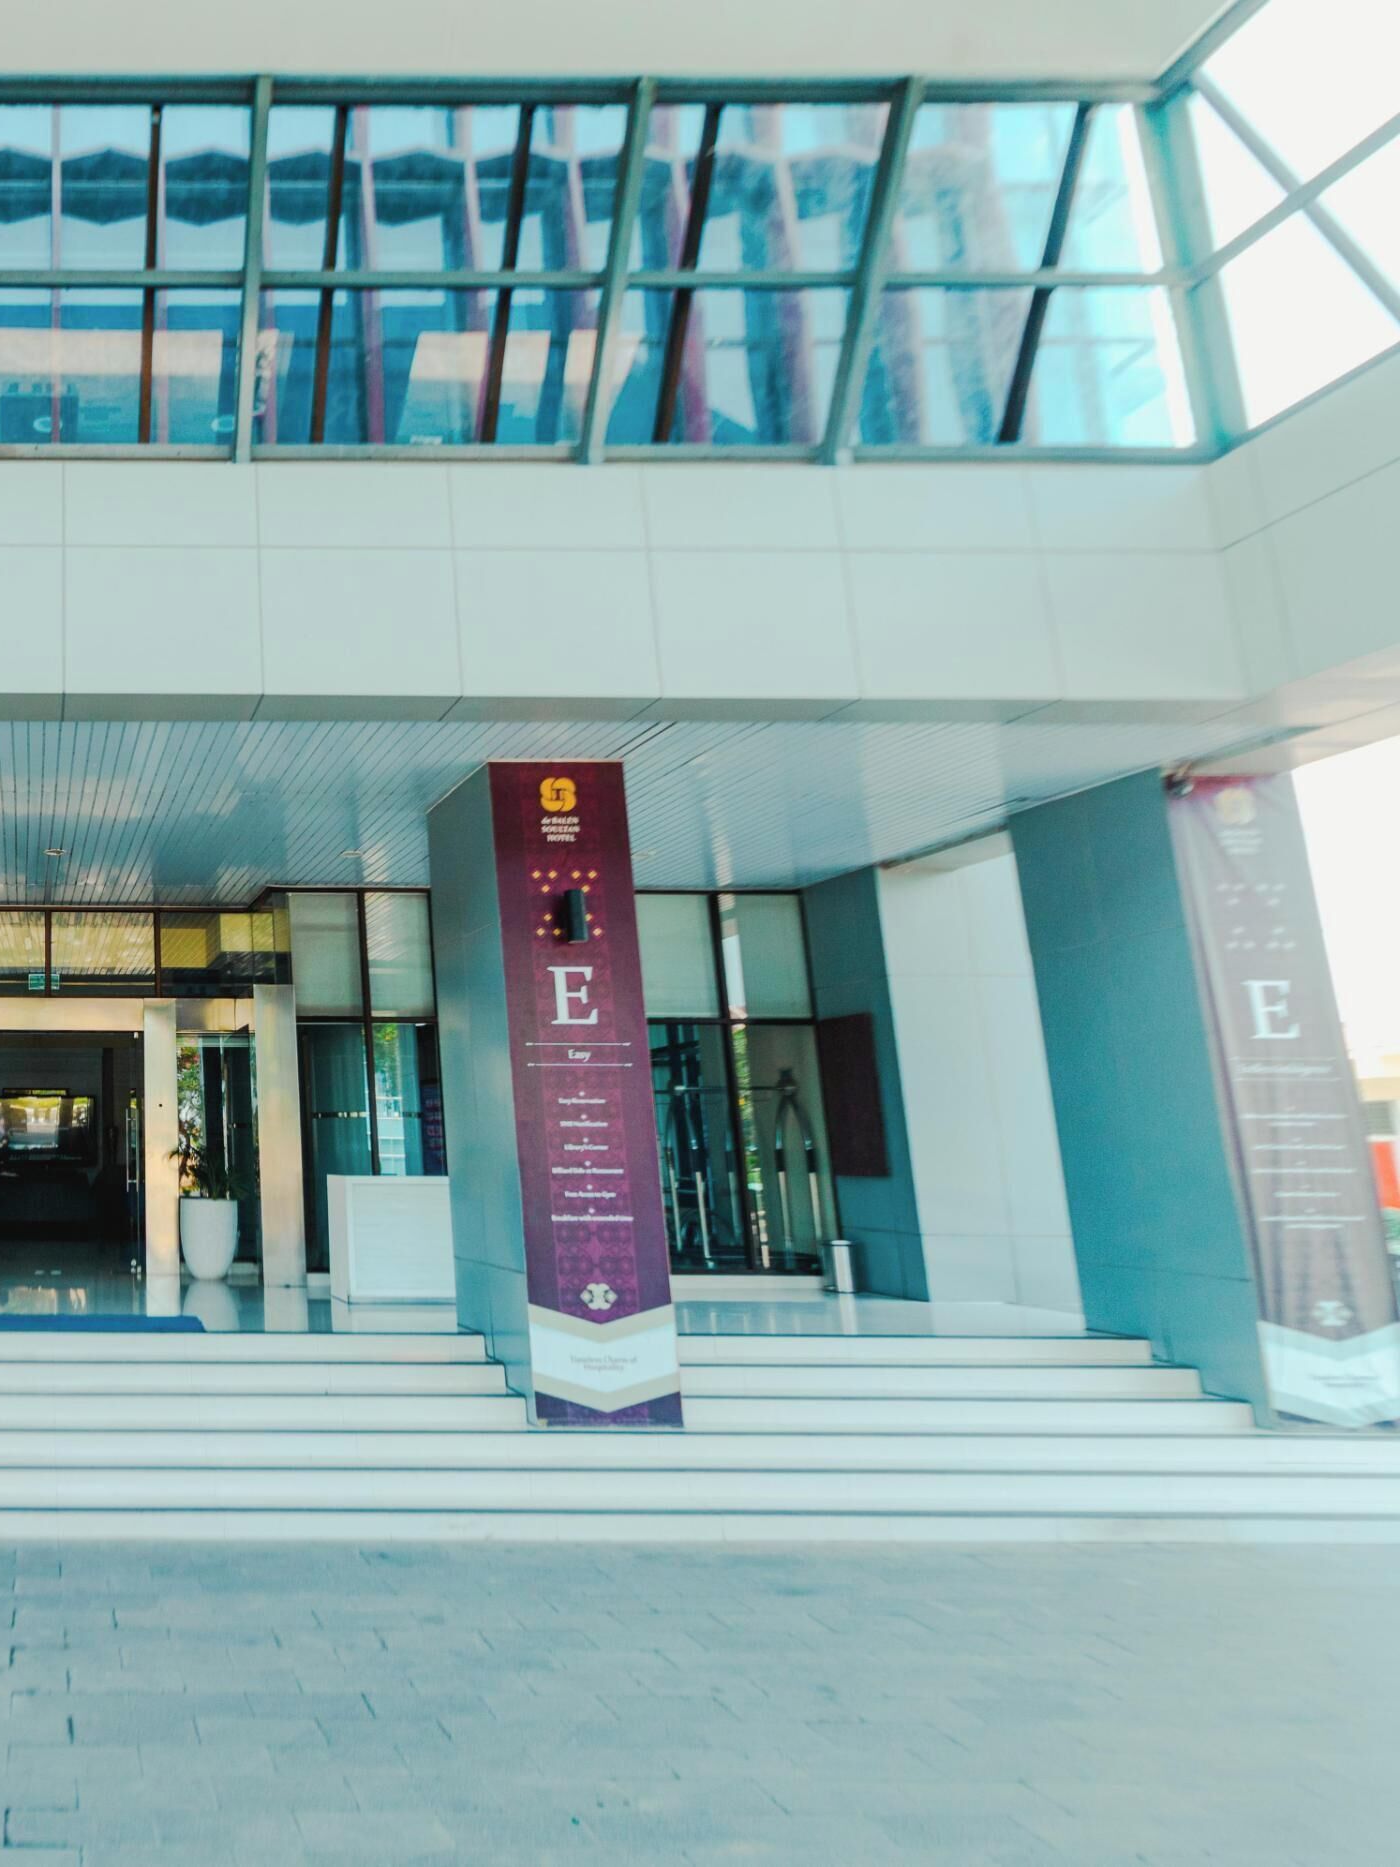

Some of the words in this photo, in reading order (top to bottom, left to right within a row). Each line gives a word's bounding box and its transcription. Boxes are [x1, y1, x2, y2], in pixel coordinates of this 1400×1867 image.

[546, 834, 576, 842] HOTEL
[546, 966, 598, 1025] E
[1240, 979, 1301, 1040] E
[567, 1049, 592, 1062] Easy
